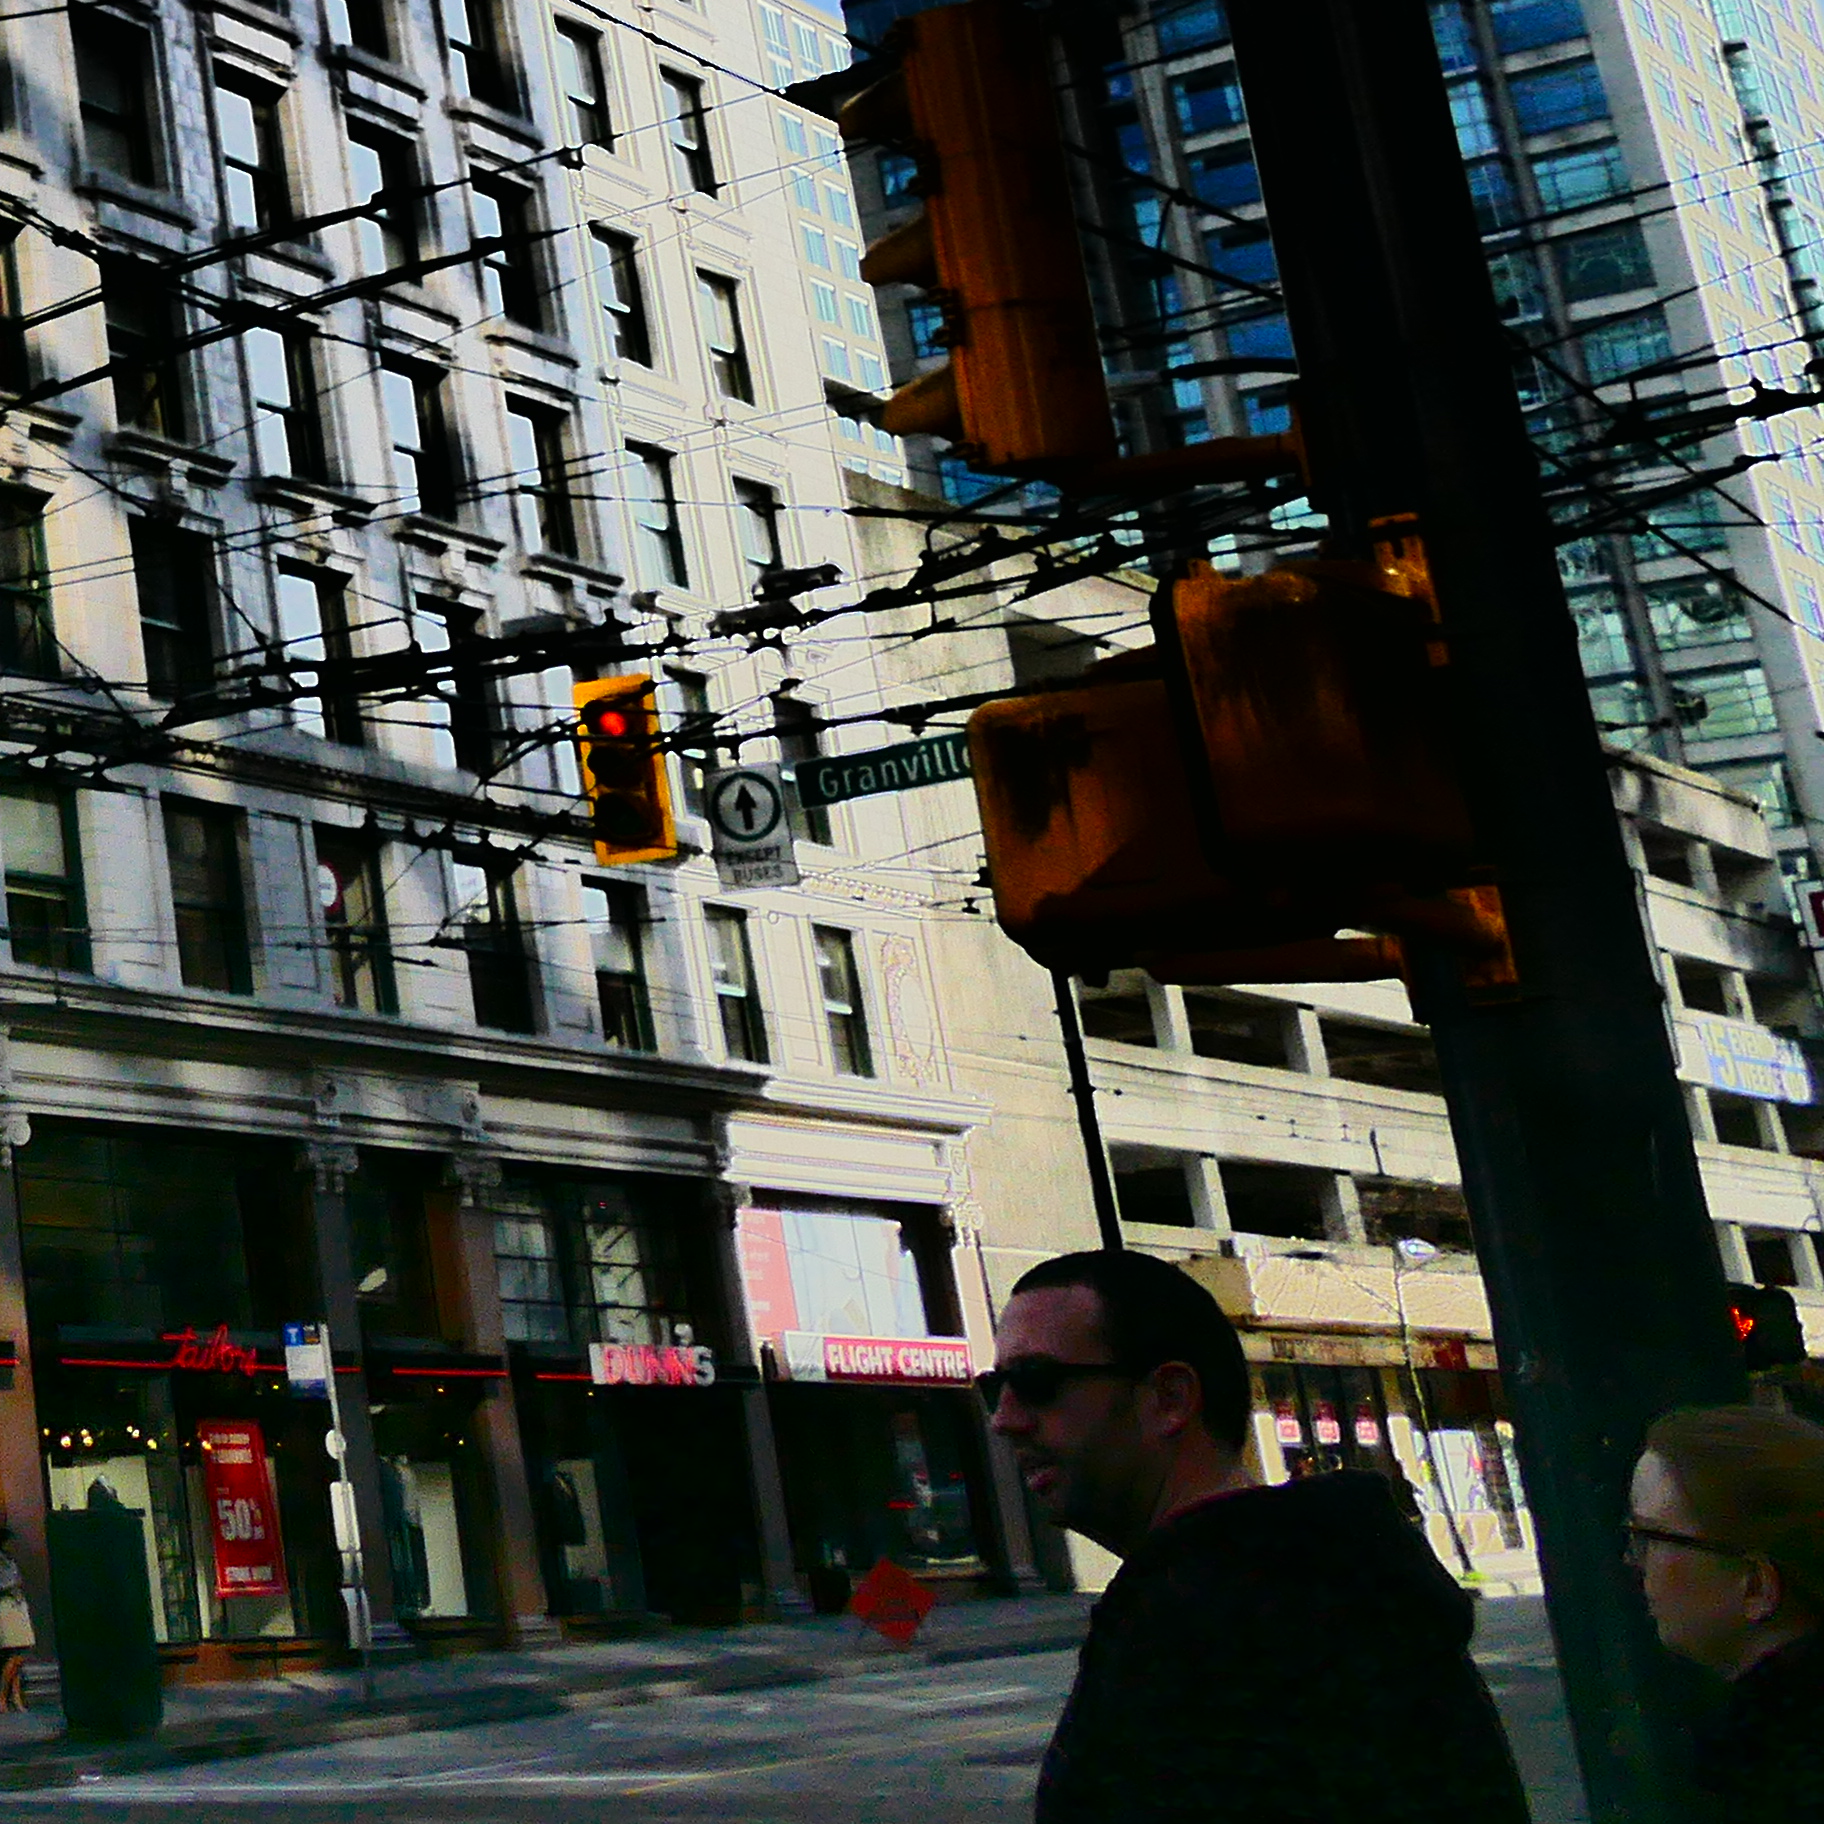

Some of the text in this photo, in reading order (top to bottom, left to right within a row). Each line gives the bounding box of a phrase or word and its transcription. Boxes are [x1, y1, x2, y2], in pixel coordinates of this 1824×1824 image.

[723, 845, 782, 865] EXCEPT
[732, 865, 783, 884] BUSES
[827, 1343, 967, 1380] FLIGHT CENTRE
